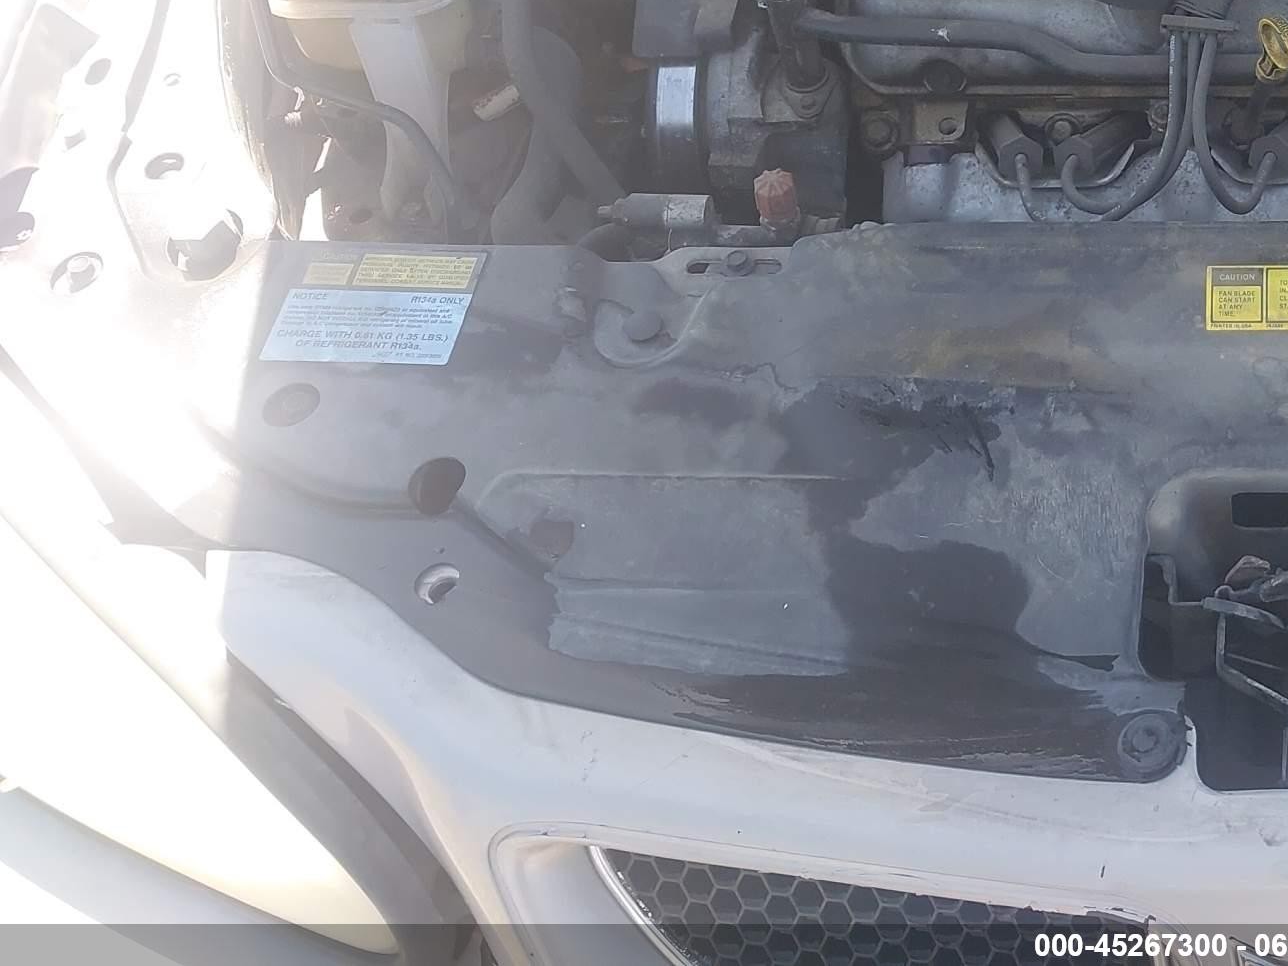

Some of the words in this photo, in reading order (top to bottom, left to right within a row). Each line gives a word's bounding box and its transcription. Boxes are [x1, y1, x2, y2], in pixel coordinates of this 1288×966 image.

[1219, 273, 1256, 281] CAUTION
[293, 292, 329, 300] NOTICE
[410, 295, 437, 304] R134a
[439, 296, 465, 305] ONLY
[276, 329, 321, 338] CHARGE
[326, 330, 353, 339] WITH
[379, 331, 393, 340] KG
[421, 333, 449, 343] LBS.)
[295, 339, 311, 347] OF
[312, 339, 388, 349] REFRIGERANT
